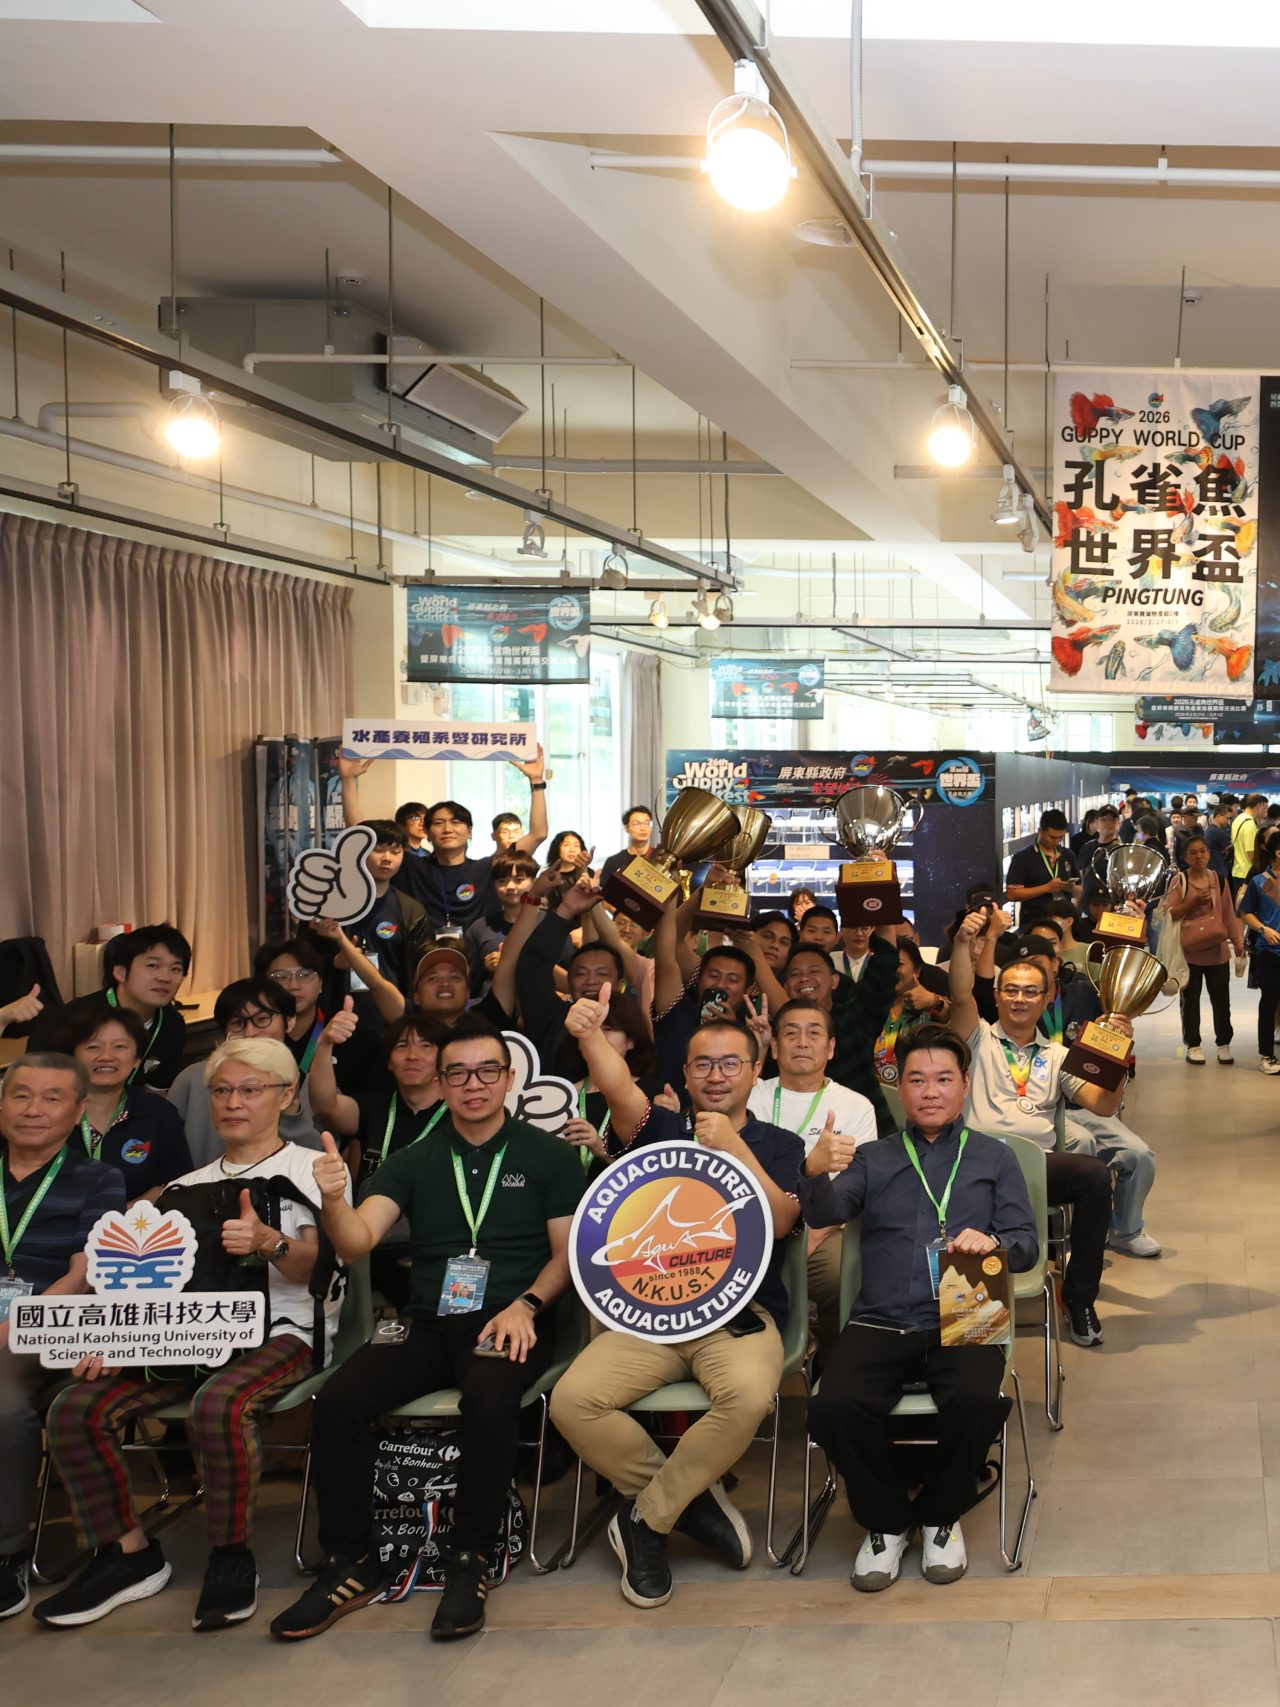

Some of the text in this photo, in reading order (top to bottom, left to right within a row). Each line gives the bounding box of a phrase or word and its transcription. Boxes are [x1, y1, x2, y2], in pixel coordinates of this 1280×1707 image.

[1138, 409, 1170, 424] 2026
[1061, 426, 1246, 451] GUPPY WORLD CUP
[1063, 459, 1247, 519] 孔雀魚
[1064, 528, 1244, 584] 世界盃
[1101, 587, 1204, 607] PINGTUNG
[351, 730, 527, 746] 水產養殖系暨研究所
[684, 761, 748, 778] World
[707, 758, 729, 767] 26th
[778, 766, 847, 780] 屏東縣政府
[672, 774, 735, 795] Guppy
[811, 781, 862, 796] 希望城
[587, 1150, 752, 1225] AQUACULTURE
[669, 1247, 734, 1268] CULTURE
[649, 1267, 701, 1282] since 1988
[632, 1266, 715, 1301] N.K.U.S.T
[595, 1267, 752, 1331] AQUACULTURE
[17, 1300, 257, 1329] 國立高雄科技大學
[17, 1328, 255, 1345] National Kaohsiung University of
[107, 1347, 136, 1359] and
[139, 1345, 224, 1360] Technology
[379, 1440, 434, 1456] Carrefour
[402, 1456, 443, 1470] Bonheur
[374, 1504, 423, 1520] rrefou
